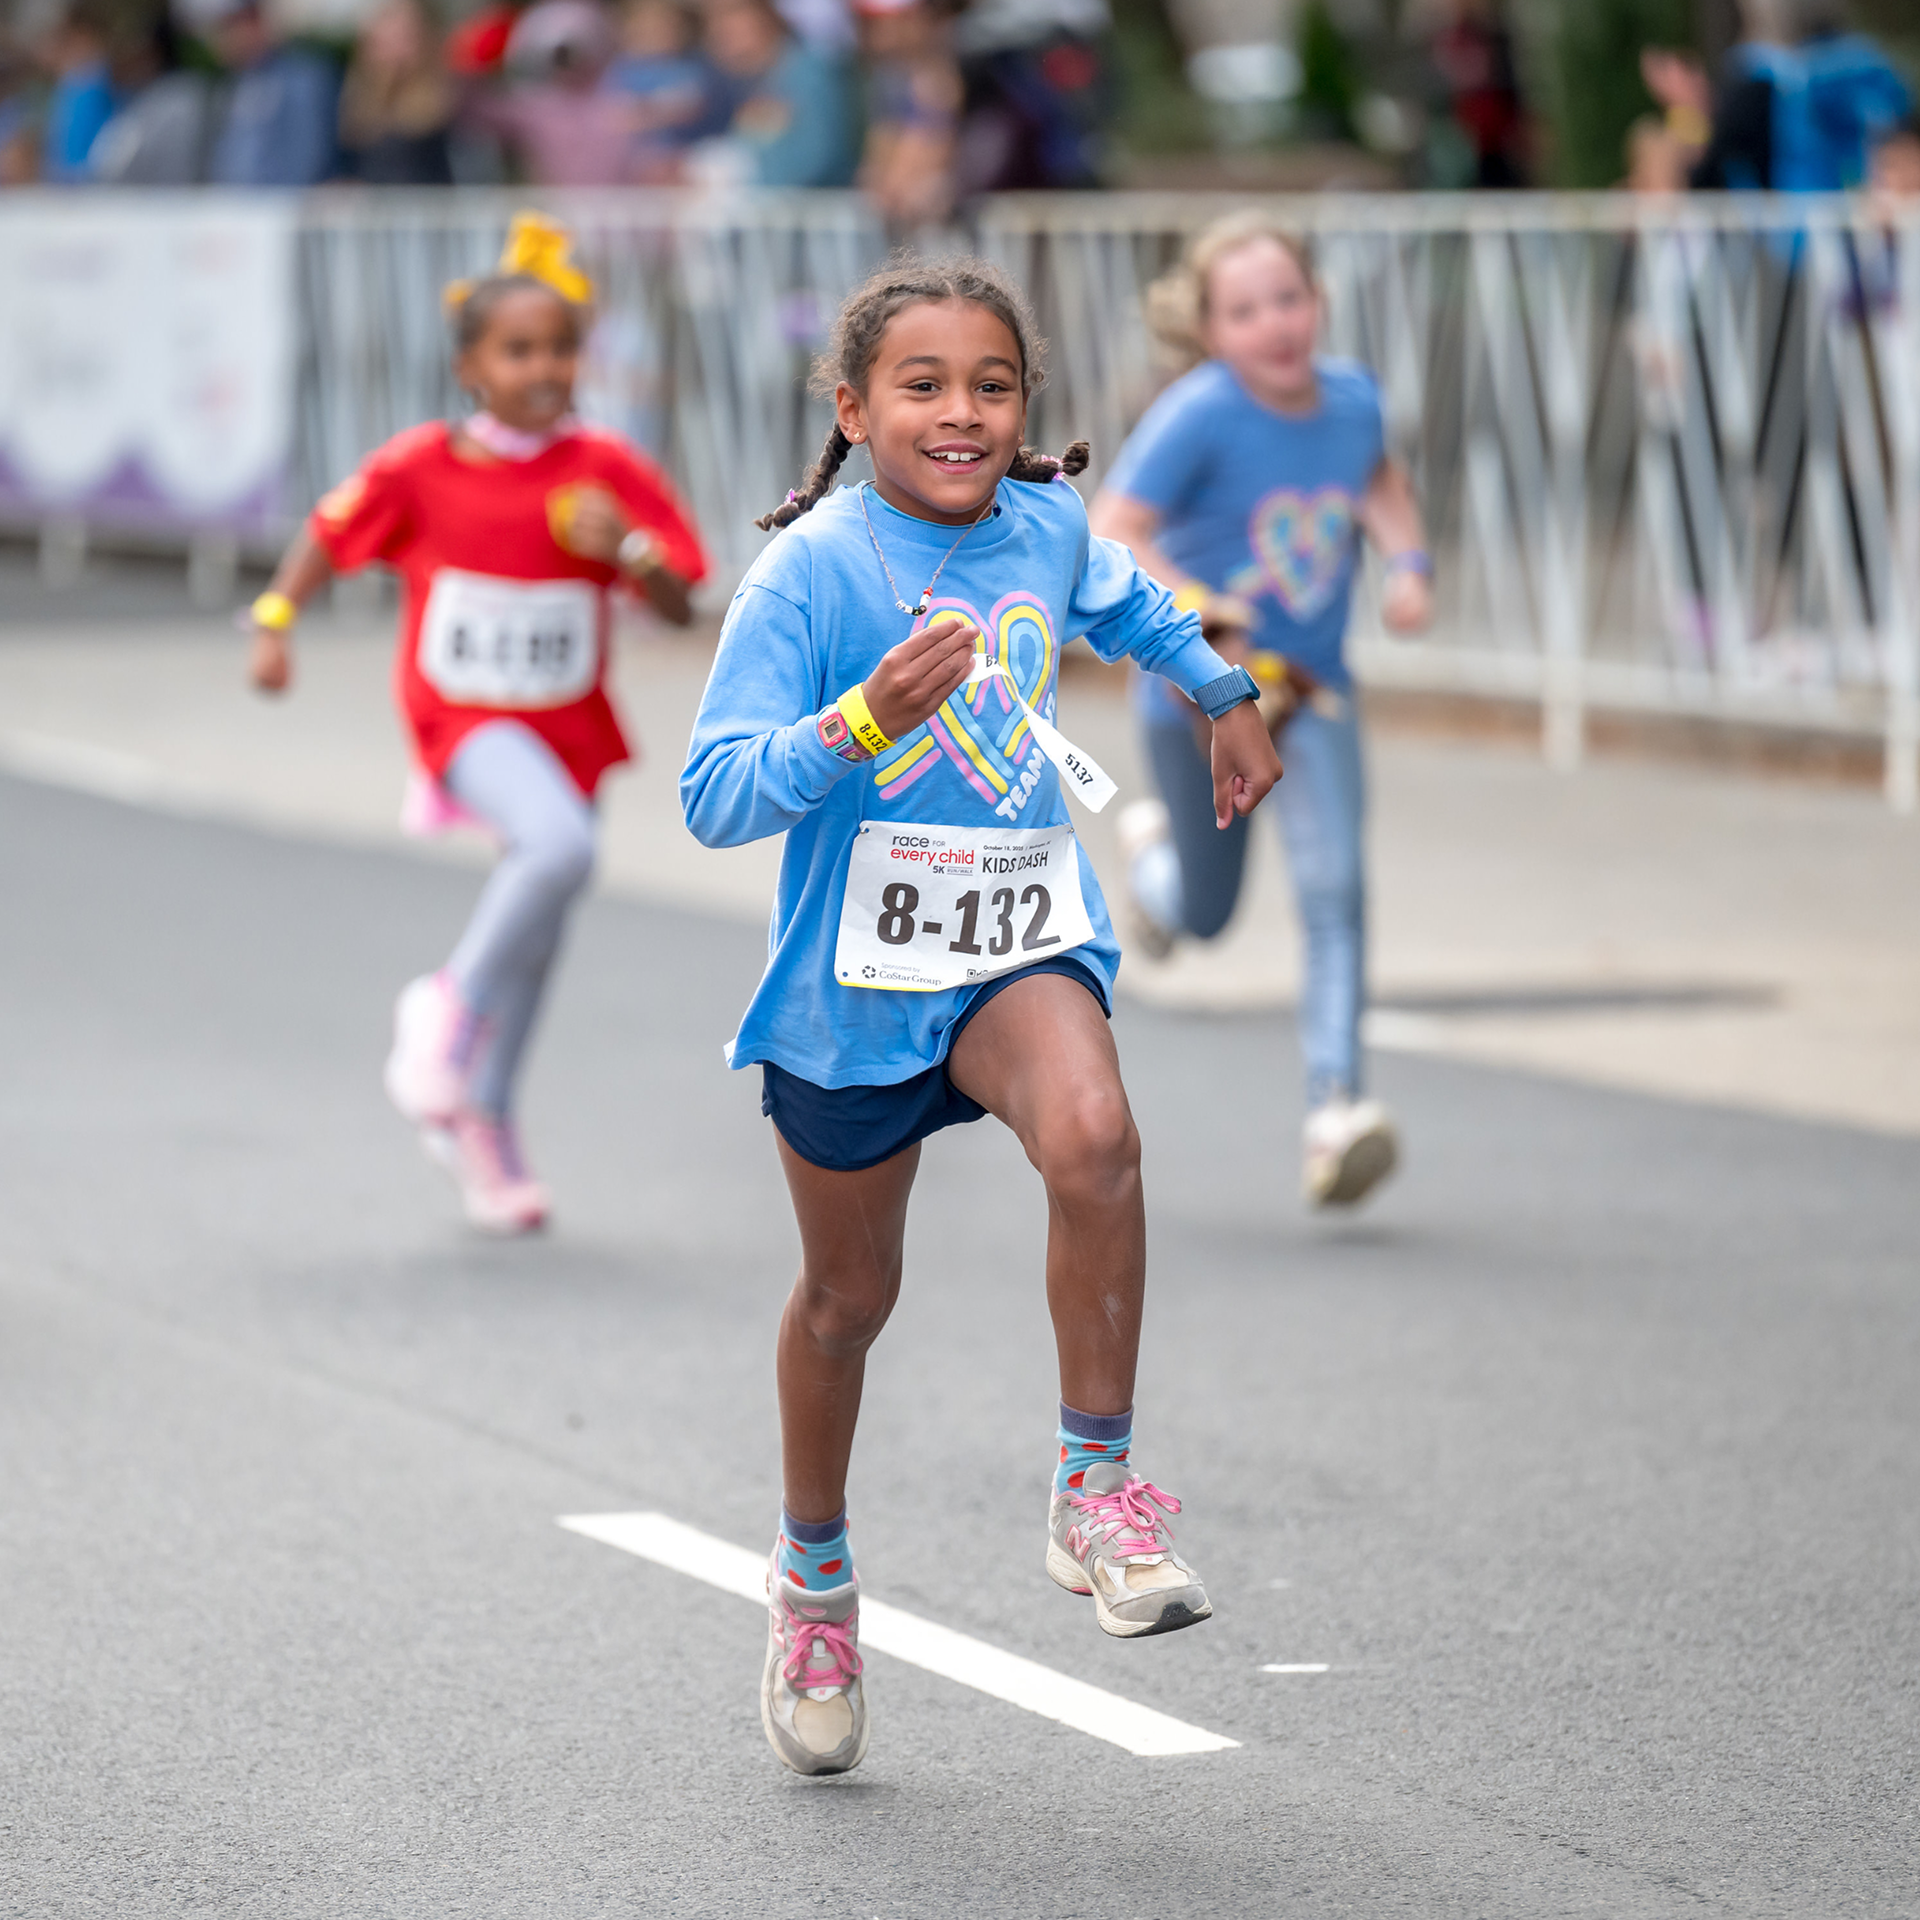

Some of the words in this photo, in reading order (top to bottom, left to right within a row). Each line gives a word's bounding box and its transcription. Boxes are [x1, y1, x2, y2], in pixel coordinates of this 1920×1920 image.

[859, 723, 888, 752] 8-132
[1065, 753, 1094, 785] 5137
[995, 747, 1046, 822] TEAM
[892, 835, 930, 848] race
[890, 848, 937, 866] every
[938, 848, 974, 864] child
[982, 857, 1017, 873] KIDS
[1017, 851, 1049, 871] DASH
[932, 865, 945, 874] 5K
[877, 882, 1061, 956] 8-132
[881, 962, 912, 972] Sponsored
